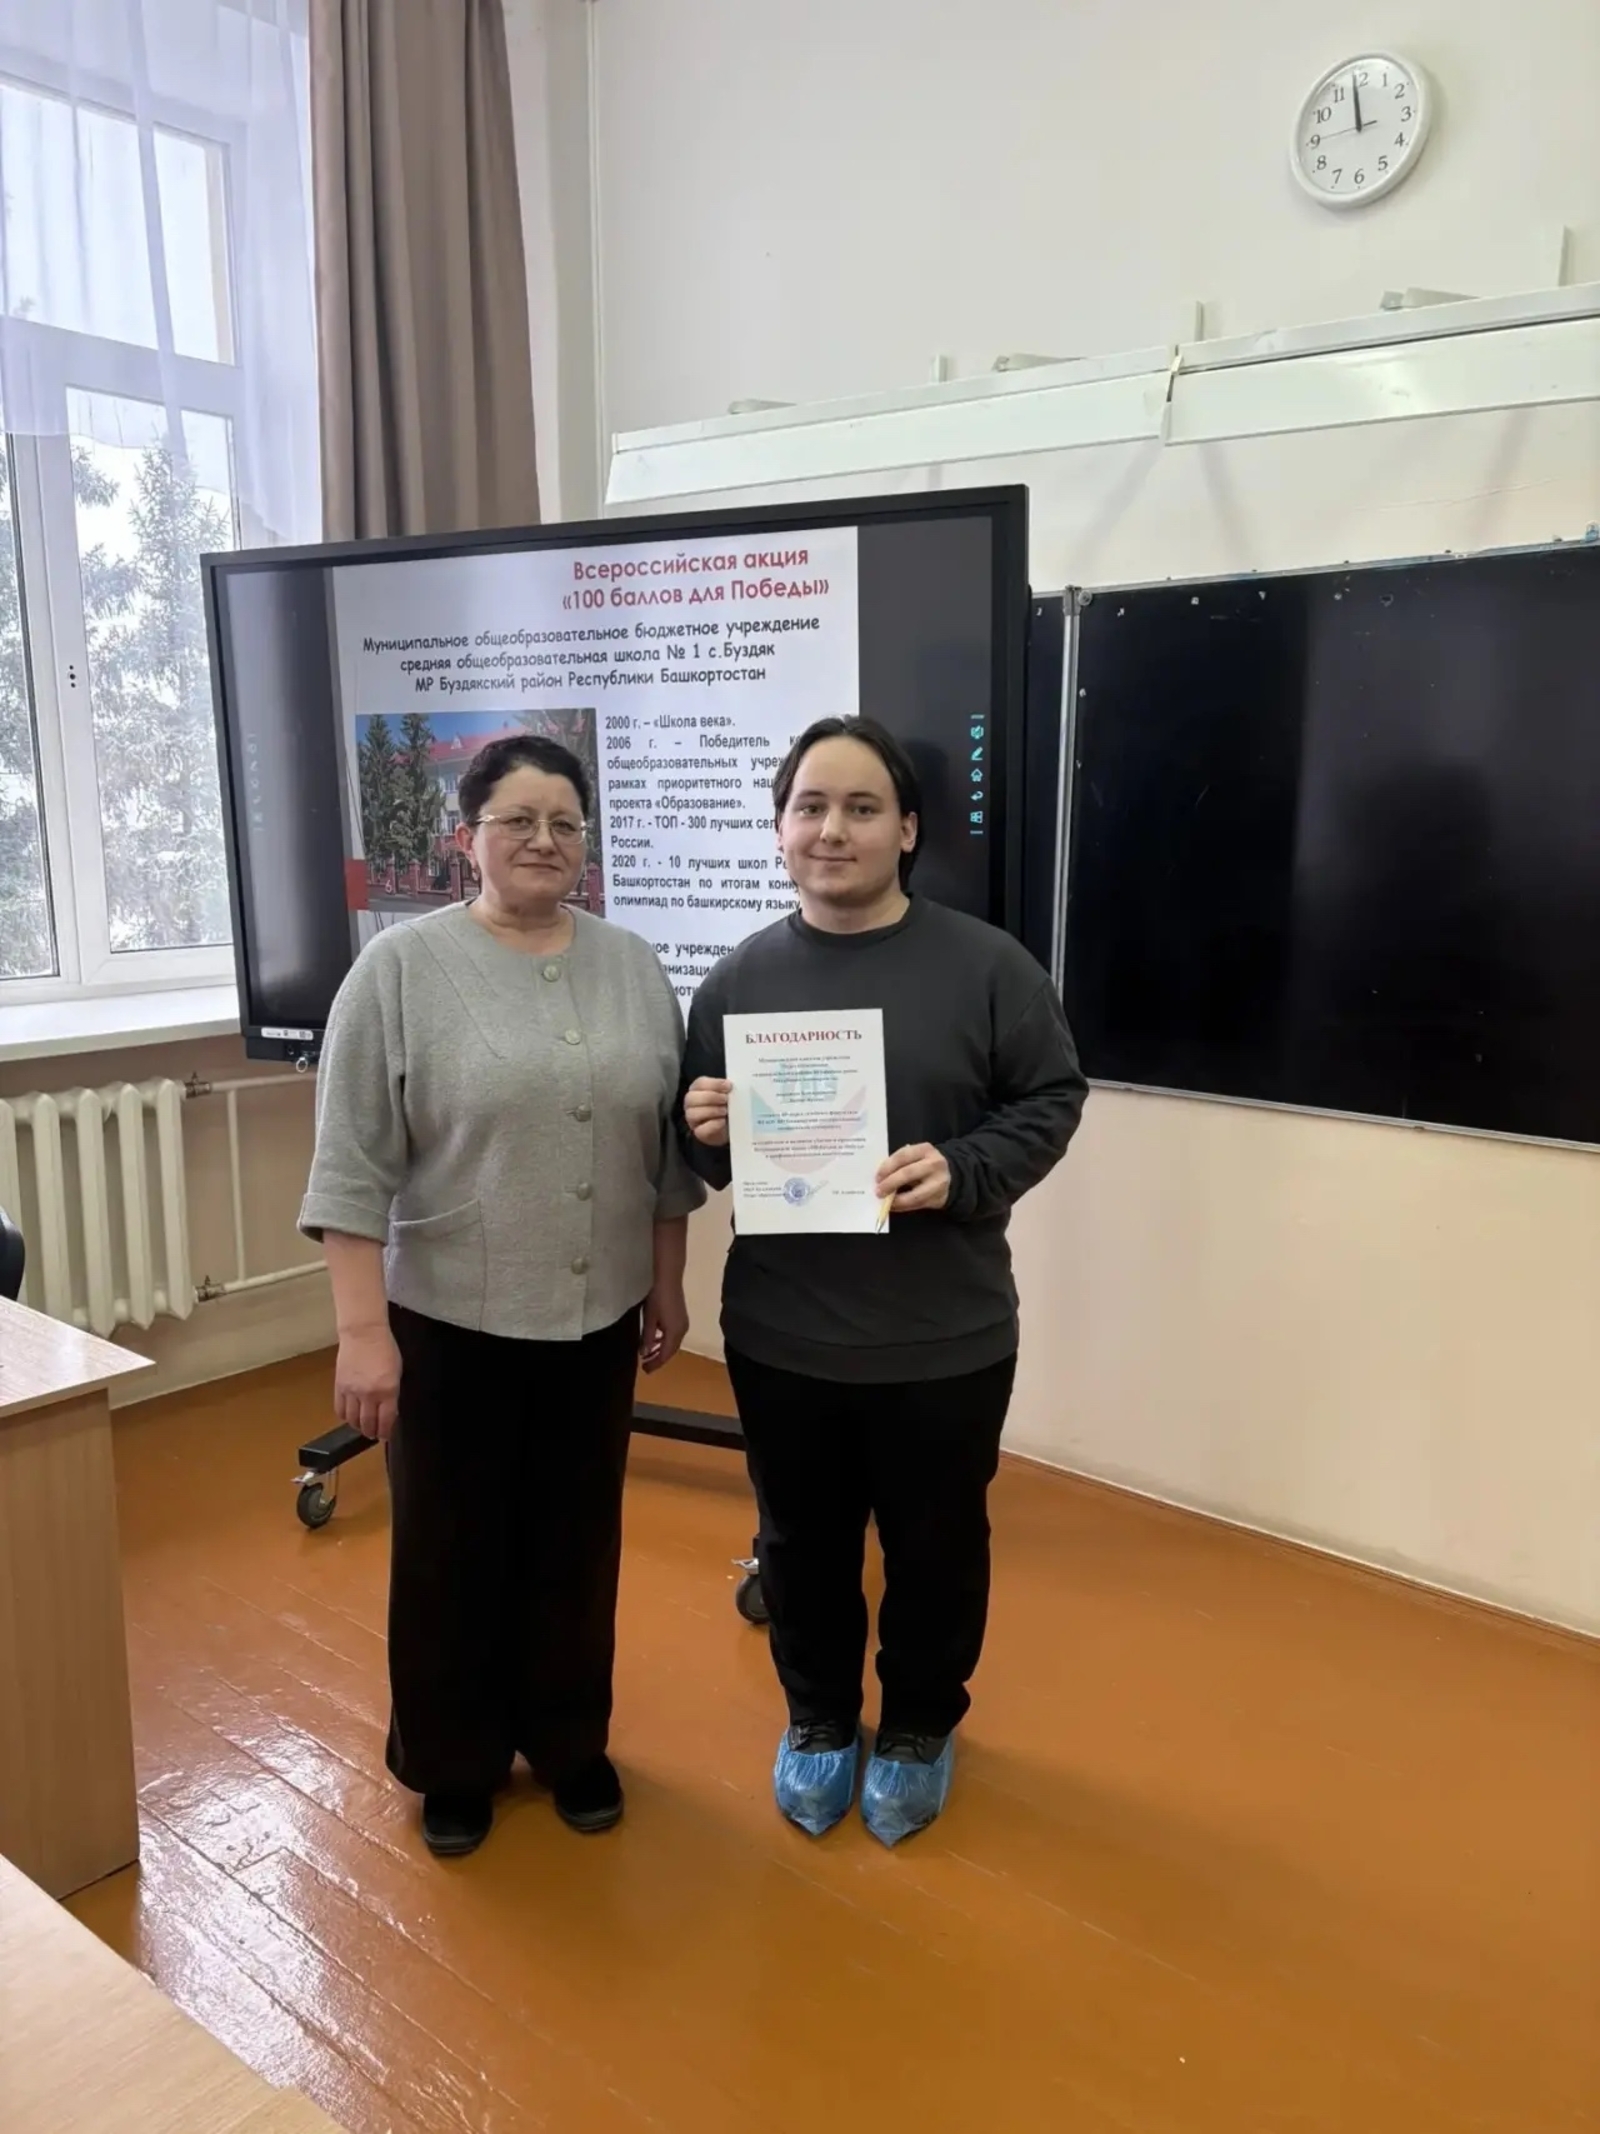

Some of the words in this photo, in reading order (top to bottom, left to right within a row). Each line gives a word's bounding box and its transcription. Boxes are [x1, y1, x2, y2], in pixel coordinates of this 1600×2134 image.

[1333, 87, 1345, 103] 11
[1394, 83, 1406, 99] 2
[1315, 107, 1332, 124] 10
[1400, 106, 1412, 122] 3
[1310, 134, 1321, 150] 9
[1394, 132, 1405, 147] 4
[1316, 155, 1327, 170] 8
[1377, 155, 1388, 171] 5
[1332, 168, 1343, 184] 7
[1354, 168, 1365, 184] 6
[573, 553, 737, 582] Всероссийская
[743, 550, 808, 569] акция
[563, 590, 605, 610] «100
[610, 587, 682, 607] баллов
[689, 584, 724, 604] для
[731, 578, 829, 600] Победы»
[363, 635, 469, 655] Муниципальное
[475, 628, 629, 648] общеобразовательное
[635, 622, 719, 641] бюджетное
[726, 616, 820, 638] учреждение
[400, 657, 451, 675] средняя
[457, 651, 608, 670] общеобразовательная
[614, 649, 660, 662] школа
[667, 644, 685, 660] №
[693, 643, 701, 659] 1
[415, 676, 434, 692] МР
[439, 673, 515, 695] Буздякский
[521, 672, 563, 692] район
[568, 670, 654, 690] Республики
[661, 667, 766, 687] Башкортостан
[605, 716, 630, 729] 2000
[653, 714, 697, 729] «Школа
[606, 736, 631, 750] 2006
[699, 734, 770, 749] Победитель
[607, 755, 738, 772] общеобразовательных
[608, 779, 647, 793] рамках
[657, 777, 742, 792] приоритетного
[609, 798, 652, 811] проекта
[655, 796, 746, 812] «Образование».
[610, 816, 634, 829] 2017
[655, 815, 678, 829] ТОП
[688, 815, 707, 829] 300
[710, 817, 753, 832] лучших
[611, 836, 653, 848] России.
[611, 855, 636, 868] 2020
[669, 855, 681, 869] 10
[688, 857, 731, 871] лучших
[738, 858, 768, 870] школ
[613, 874, 690, 890] Башкортостан
[700, 879, 713, 889] по
[721, 879, 760, 889] итогам
[613, 895, 668, 909] олимпиад
[671, 896, 684, 908] по
[687, 894, 761, 912] башкирскому
[675, 943, 735, 958] учрежден
[745, 1029, 862, 1045] БЛАГОДАРНОСТЬ
